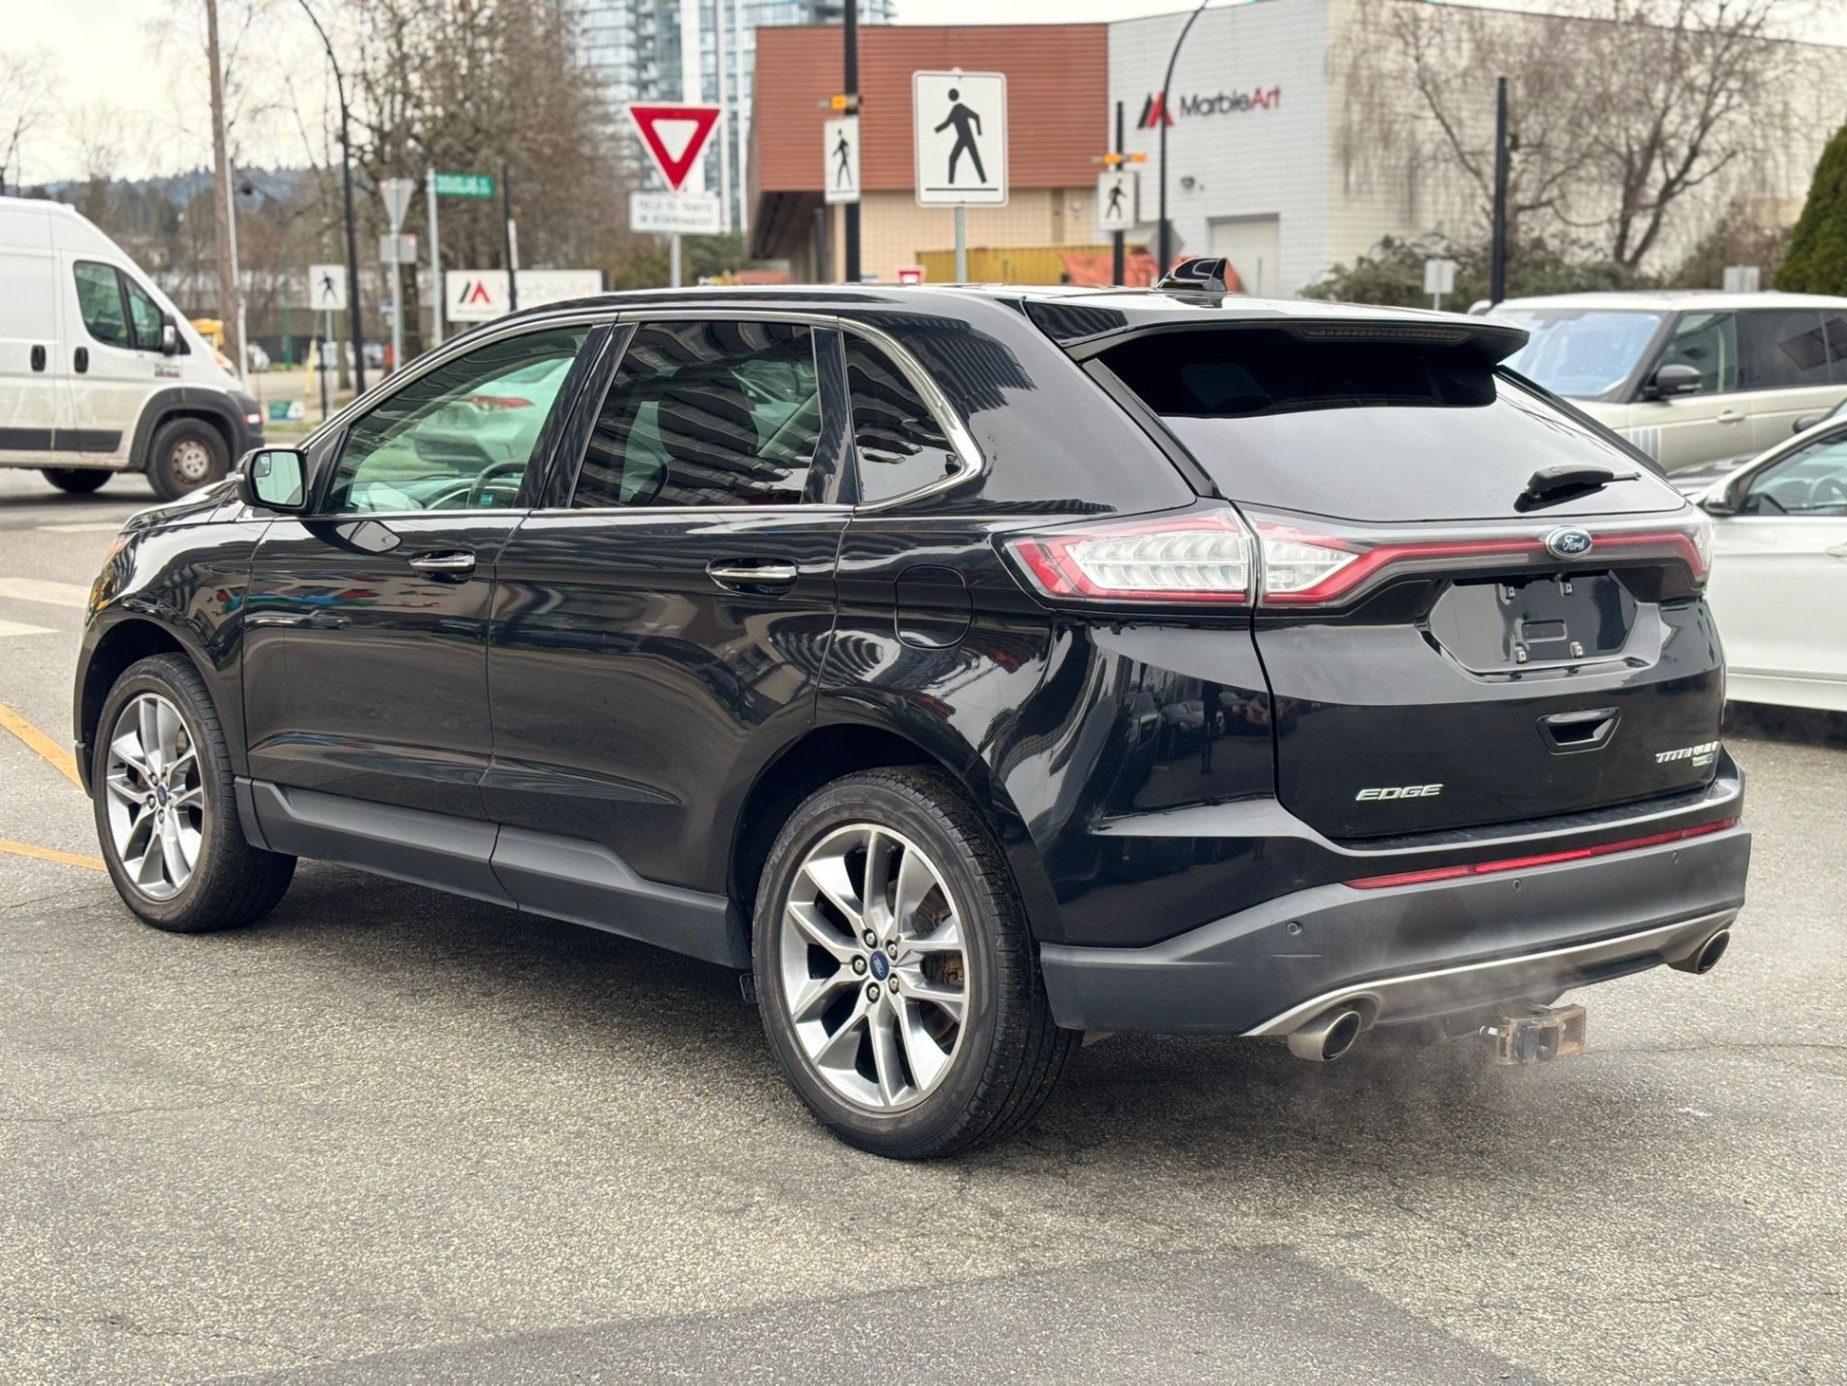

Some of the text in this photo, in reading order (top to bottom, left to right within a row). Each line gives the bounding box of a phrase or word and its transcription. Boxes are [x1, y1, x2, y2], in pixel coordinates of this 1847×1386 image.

[1180, 85, 1281, 118] MarbleArt
[1563, 534, 1585, 551] Ford
[1355, 783, 1444, 801] EDGE
